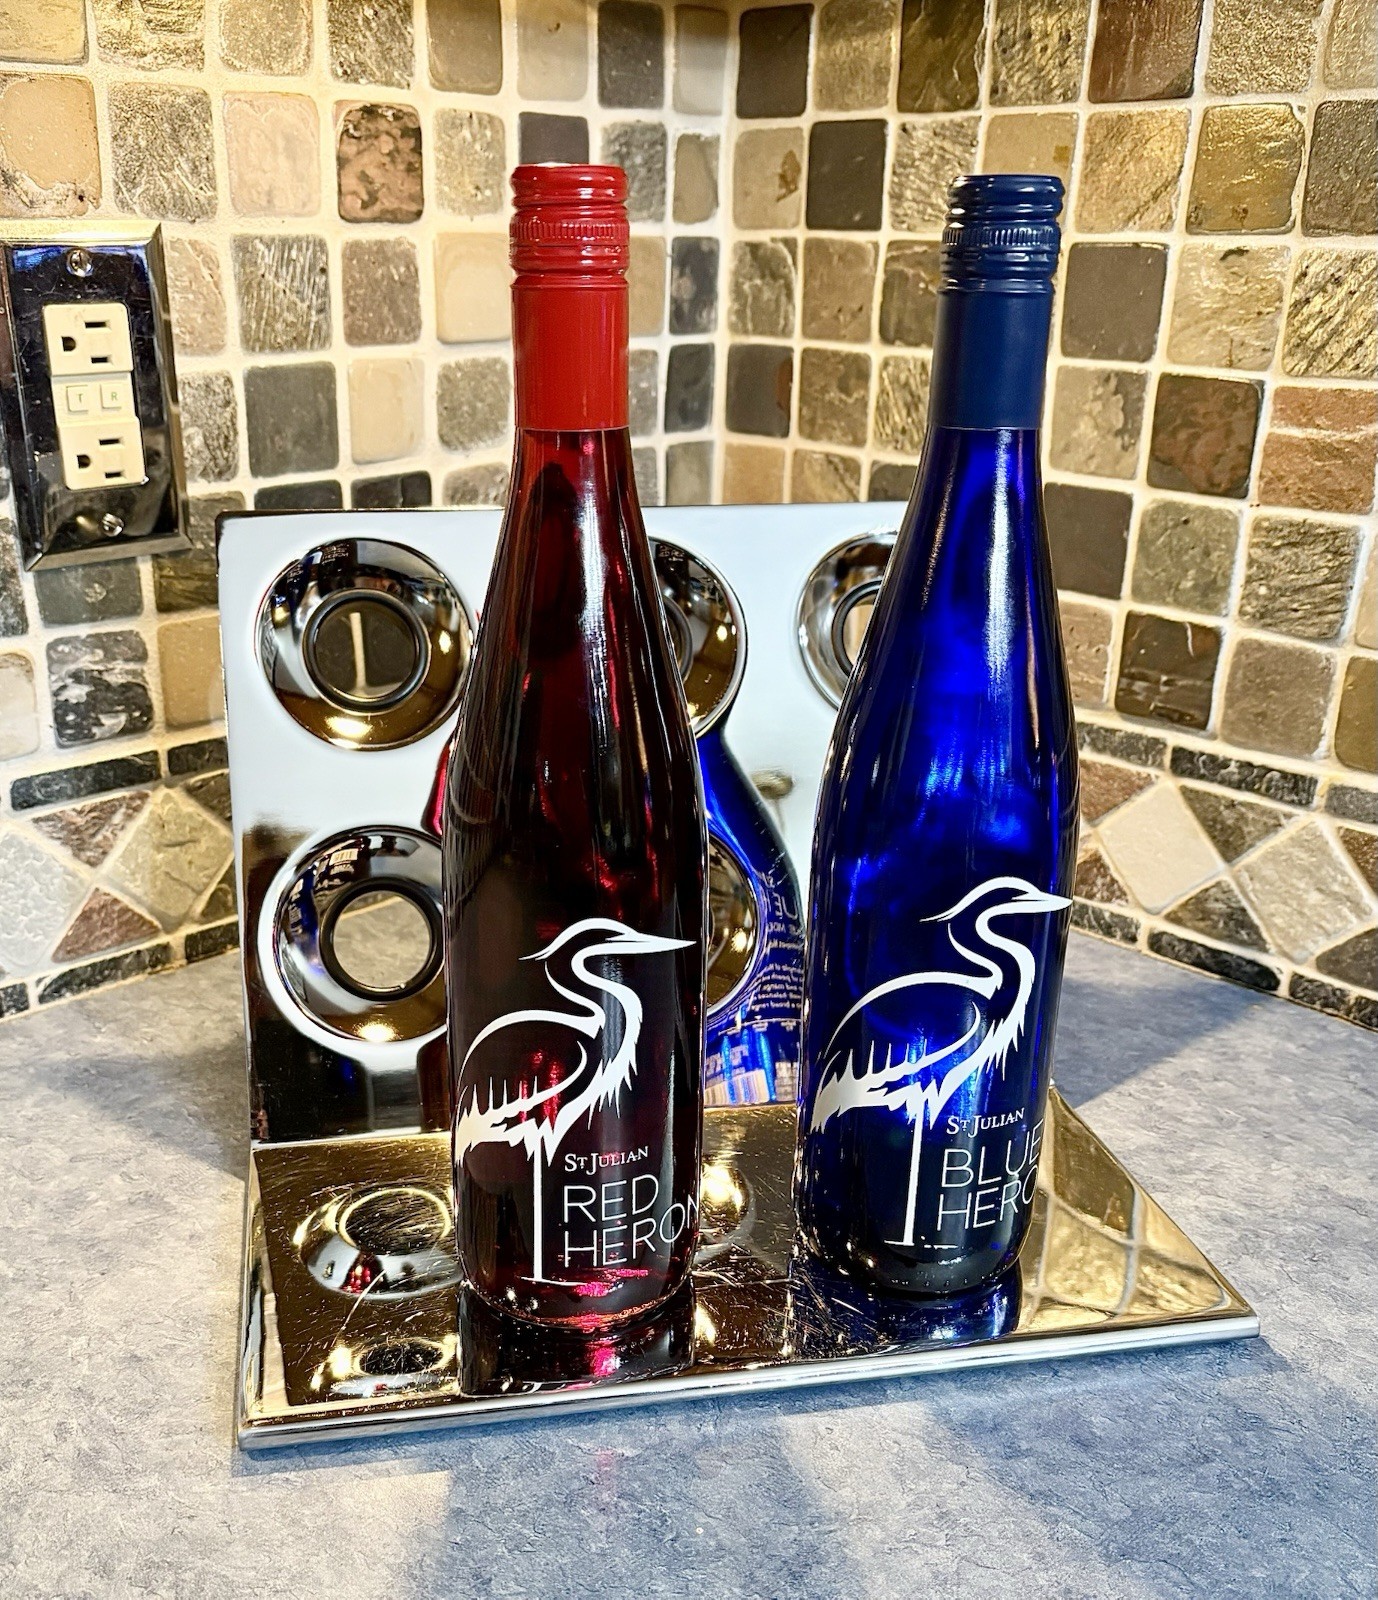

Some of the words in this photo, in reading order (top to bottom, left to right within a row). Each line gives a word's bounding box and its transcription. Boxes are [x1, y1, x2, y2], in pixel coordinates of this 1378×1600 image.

[111, 391, 118, 401] R
[941, 1118, 1044, 1188] BLUE
[563, 1173, 659, 1223] RED
